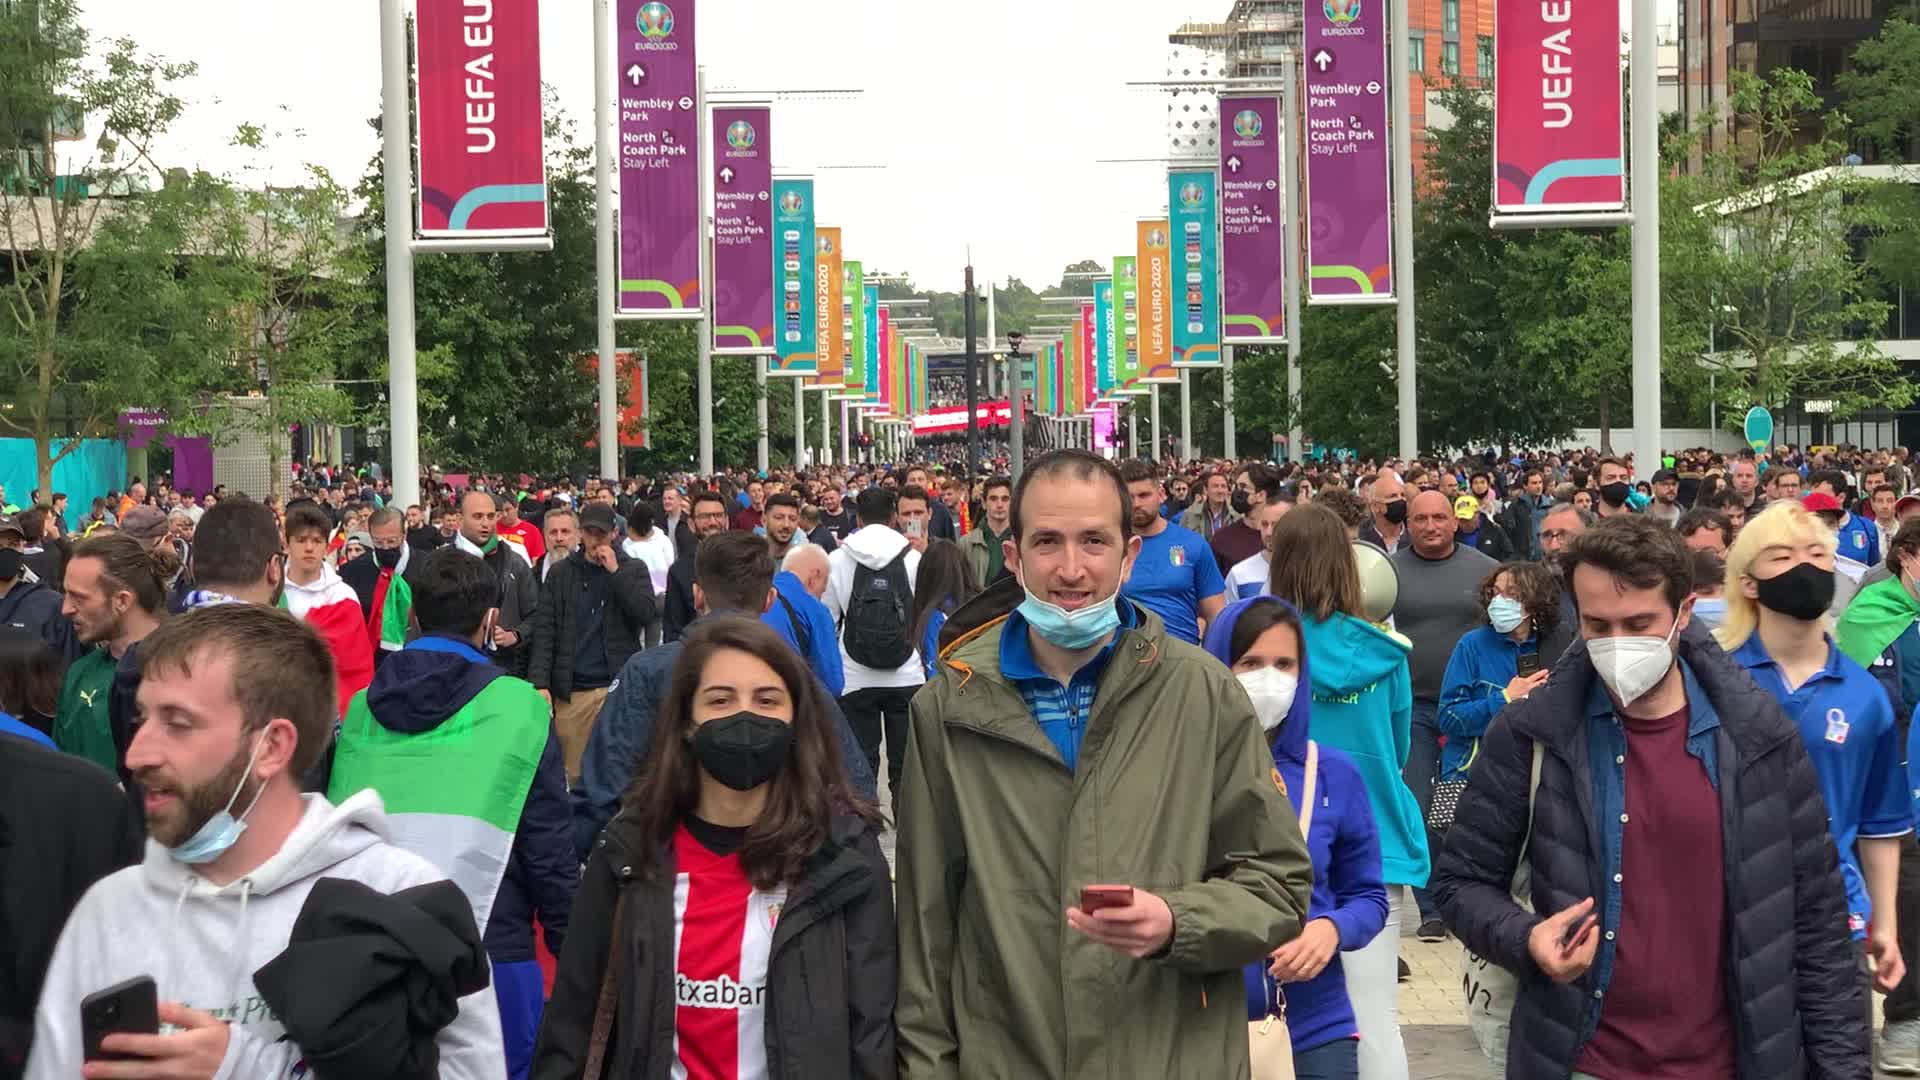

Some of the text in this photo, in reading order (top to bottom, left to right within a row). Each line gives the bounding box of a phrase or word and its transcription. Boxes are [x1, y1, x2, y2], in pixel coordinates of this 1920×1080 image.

[1542, 28, 1573, 128] UEFA
[1309, 83, 1361, 96] Wembley
[464, 53, 496, 154] UEFA
[622, 98, 674, 111] Wembley
[1310, 97, 1336, 107] Park
[623, 111, 649, 121] Park
[1311, 118, 1344, 128] North
[623, 131, 656, 142] North
[1311, 129, 1375, 141] Coach Park
[623, 143, 687, 155] Coach Park
[1311, 142, 1358, 156] Stay Left
[623, 156, 670, 170] Stay Left
[1224, 181, 1263, 191] Wembley
[716, 192, 755, 201] Wembley
[1224, 191, 1244, 199] Park
[717, 201, 736, 209] Park
[1225, 206, 1249, 215] North
[717, 217, 742, 225] North
[1225, 215, 1272, 224] Coach Park
[717, 225, 764, 234] Coach Park
[1225, 224, 1259, 235] Stay Left
[717, 235, 752, 245] Stay Left
[1151, 257, 1163, 355] UEFA EURO 2020
[818, 264, 829, 361] UEFA EURO 2020
